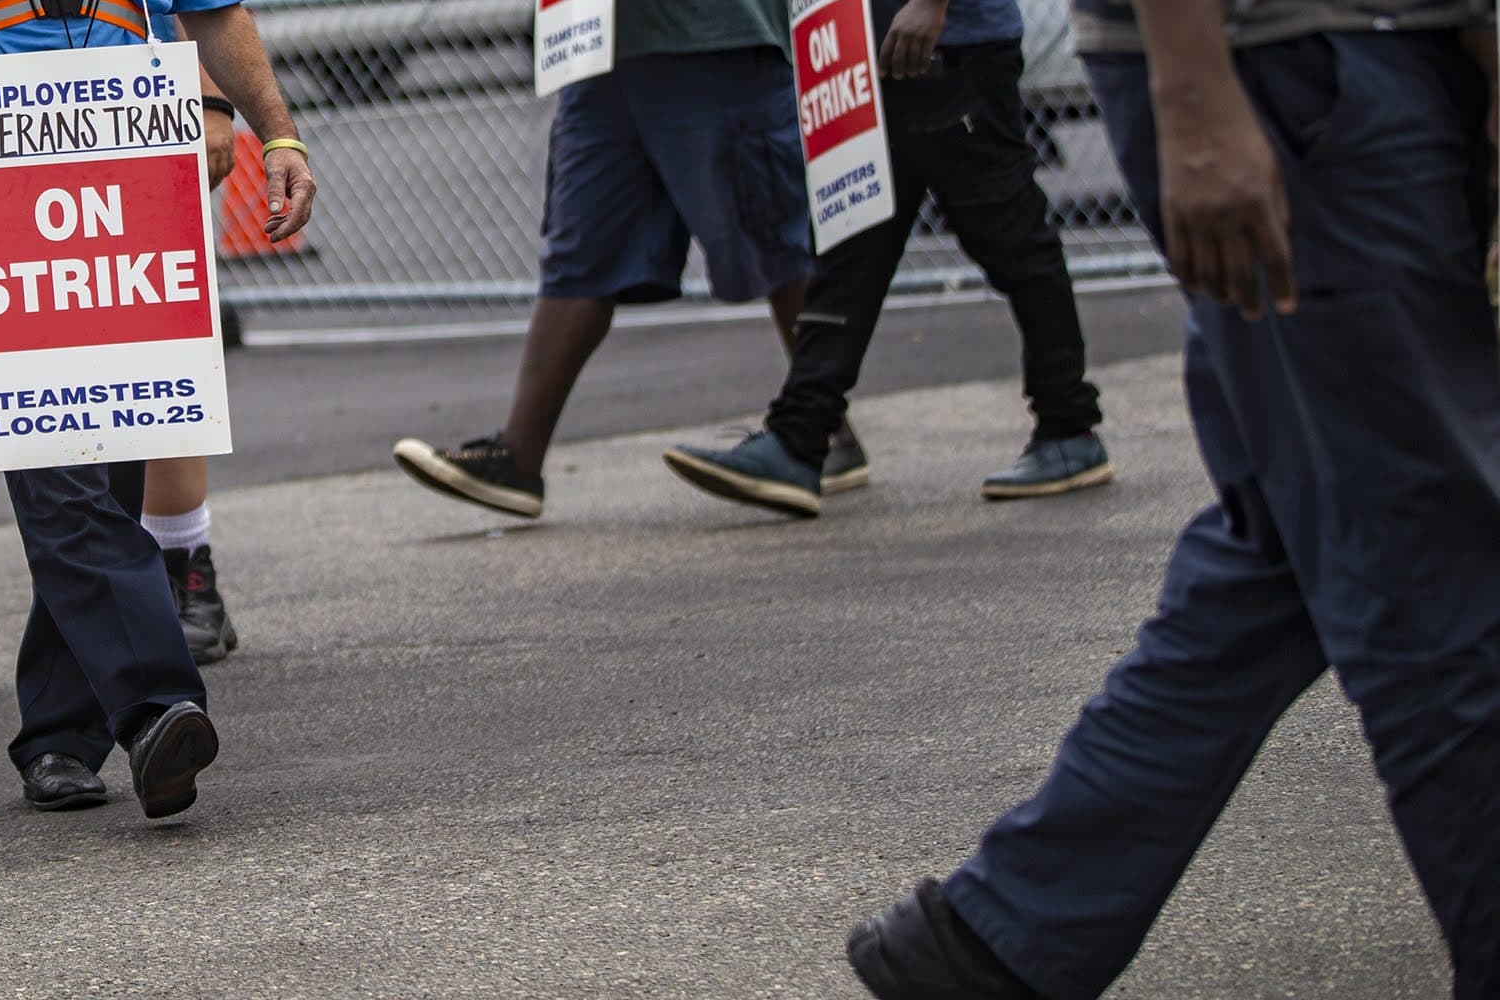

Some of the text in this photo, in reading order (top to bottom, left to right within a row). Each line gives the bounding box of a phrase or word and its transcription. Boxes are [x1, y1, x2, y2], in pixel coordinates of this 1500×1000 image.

[543, 15, 601, 52] TEAMSTERS
[809, 19, 840, 73] ON
[133, 75, 176, 99] OF:
[800, 60, 872, 137] STRIKE
[103, 98, 201, 146] TRANS
[816, 162, 876, 205] TEAMSTERS
[35, 184, 125, 242] ON
[817, 199, 846, 225] LOCAL
[112, 404, 205, 428] No.25
